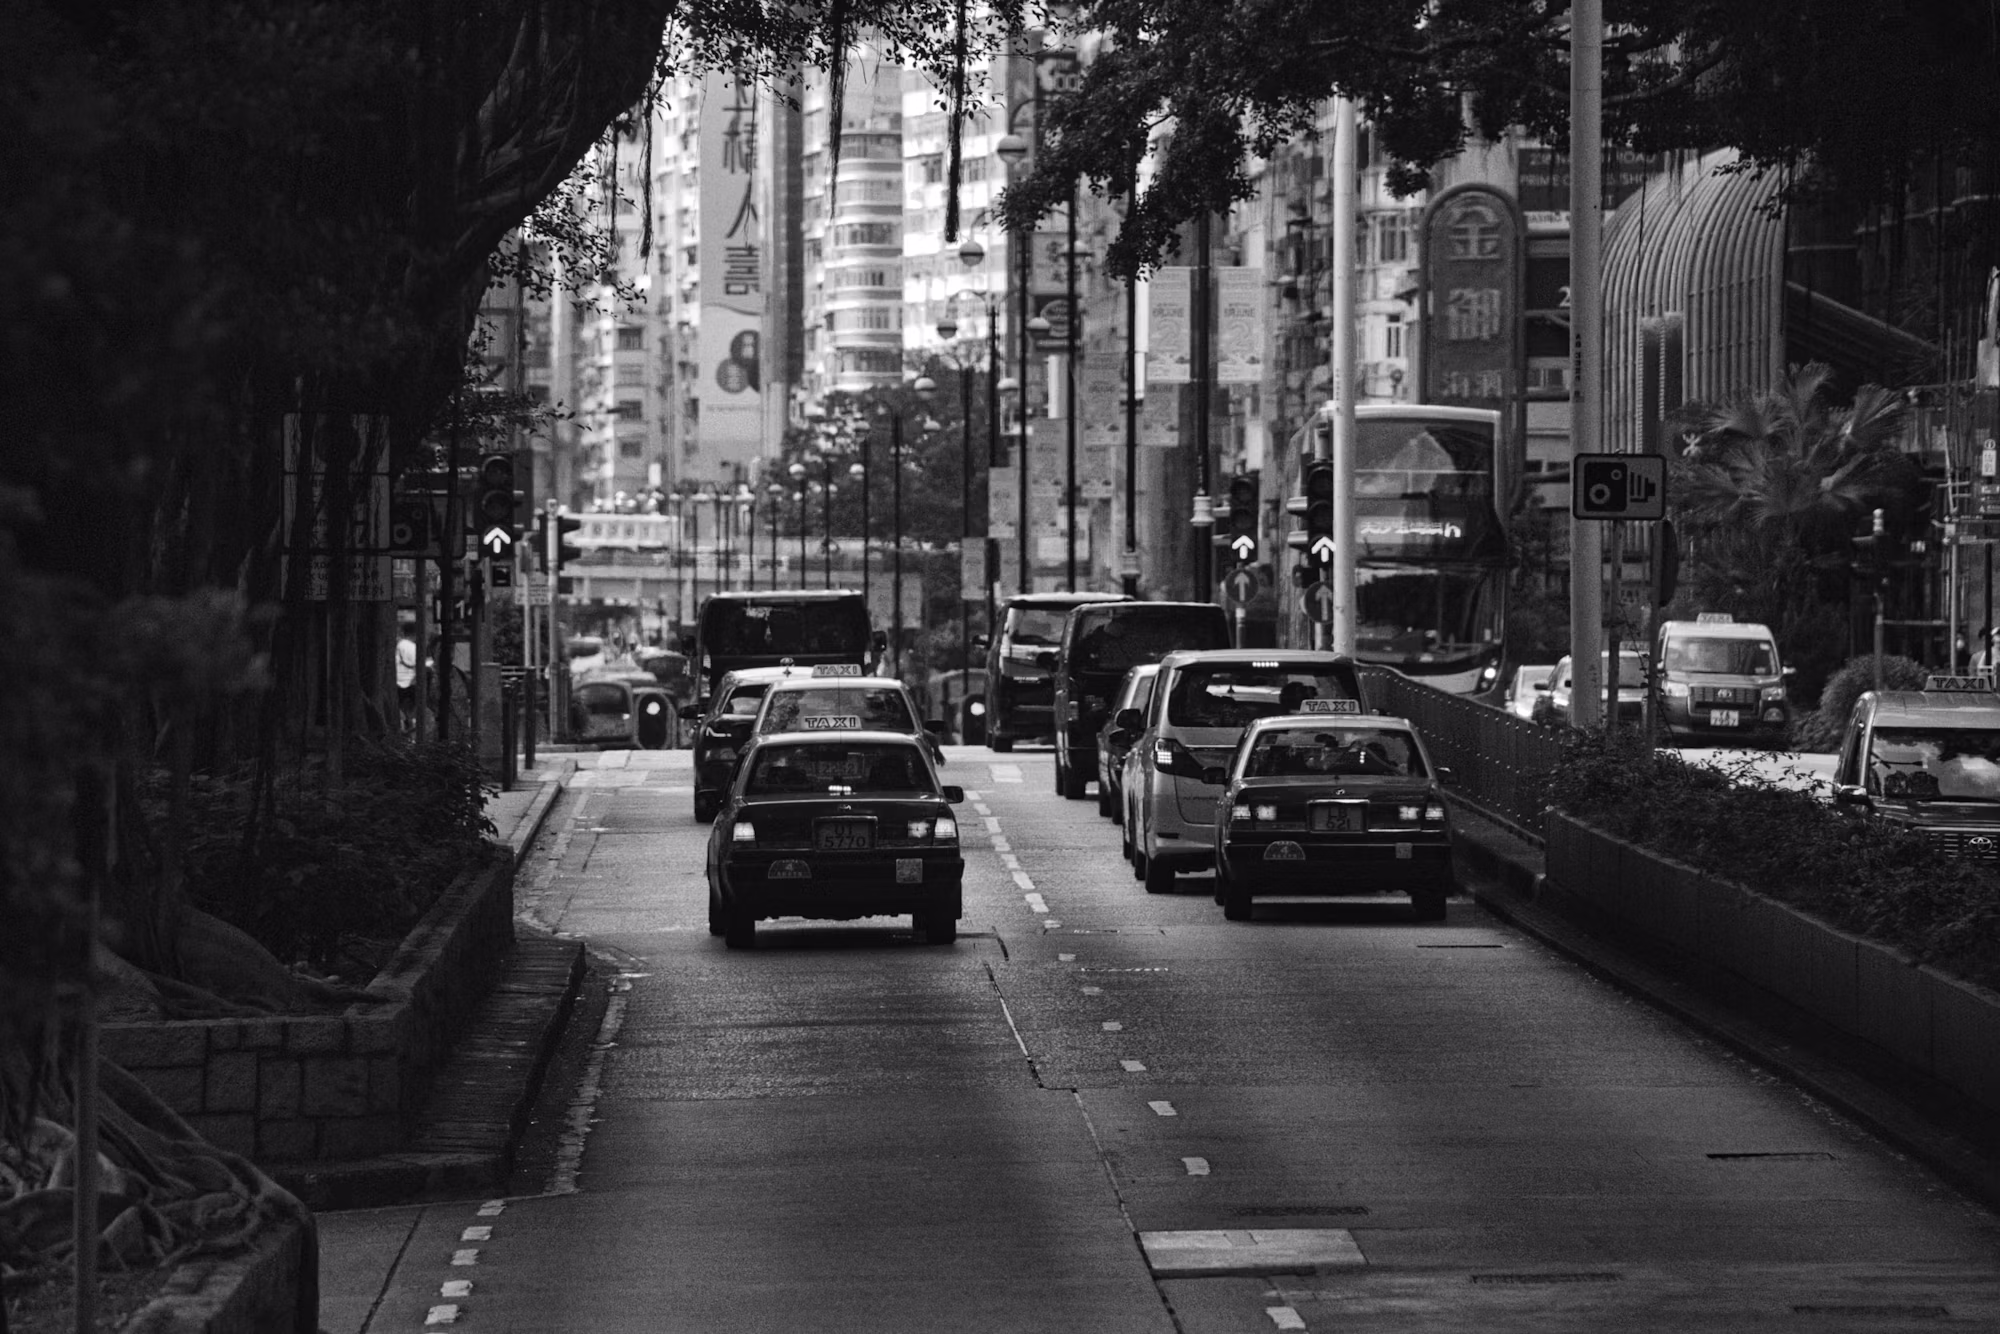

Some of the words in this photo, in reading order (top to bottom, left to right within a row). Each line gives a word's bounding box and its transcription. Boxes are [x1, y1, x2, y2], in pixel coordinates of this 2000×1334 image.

[817, 665, 858, 675] TAXI
[1933, 677, 1985, 689] TAXI
[1306, 700, 1357, 712] TAXI
[805, 717, 857, 728] TAXI
[824, 836, 866, 848] 5770
